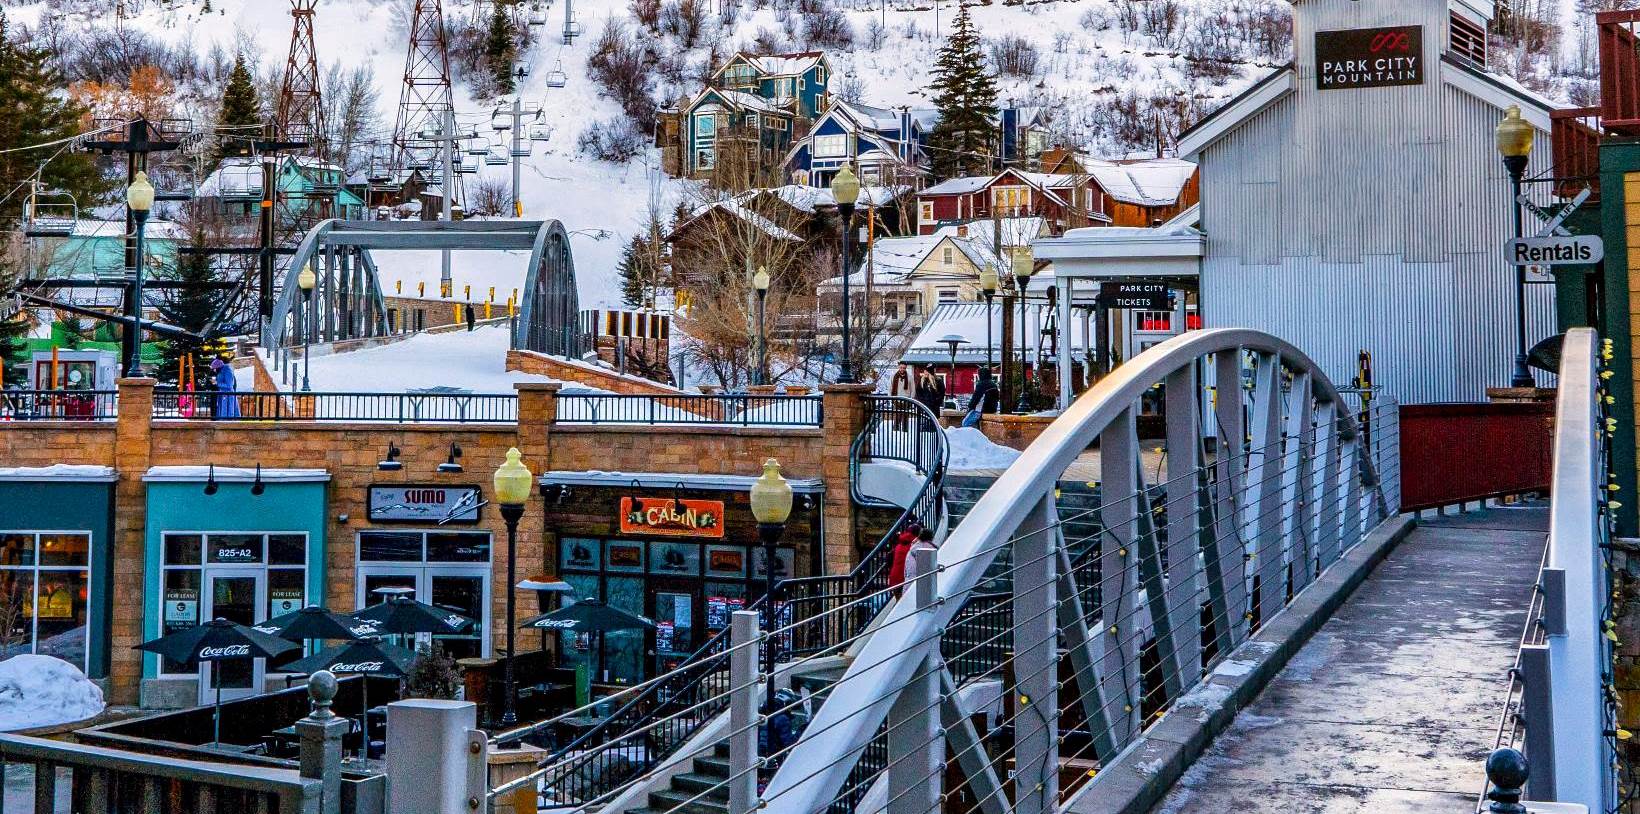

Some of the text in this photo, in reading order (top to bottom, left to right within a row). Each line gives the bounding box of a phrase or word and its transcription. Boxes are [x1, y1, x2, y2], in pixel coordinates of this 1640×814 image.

[1323, 56, 1416, 74] PARK CITY
[1323, 70, 1416, 84] MOUNTAIN
[1524, 200, 1550, 222] TOWN
[1559, 201, 1577, 219] LIFT
[1515, 241, 1592, 262] Rentals
[1116, 298, 1151, 306] TICKETS
[404, 489, 445, 504] SUMO
[646, 507, 697, 528] CABIN
[218, 549, 252, 557] 825-A2
